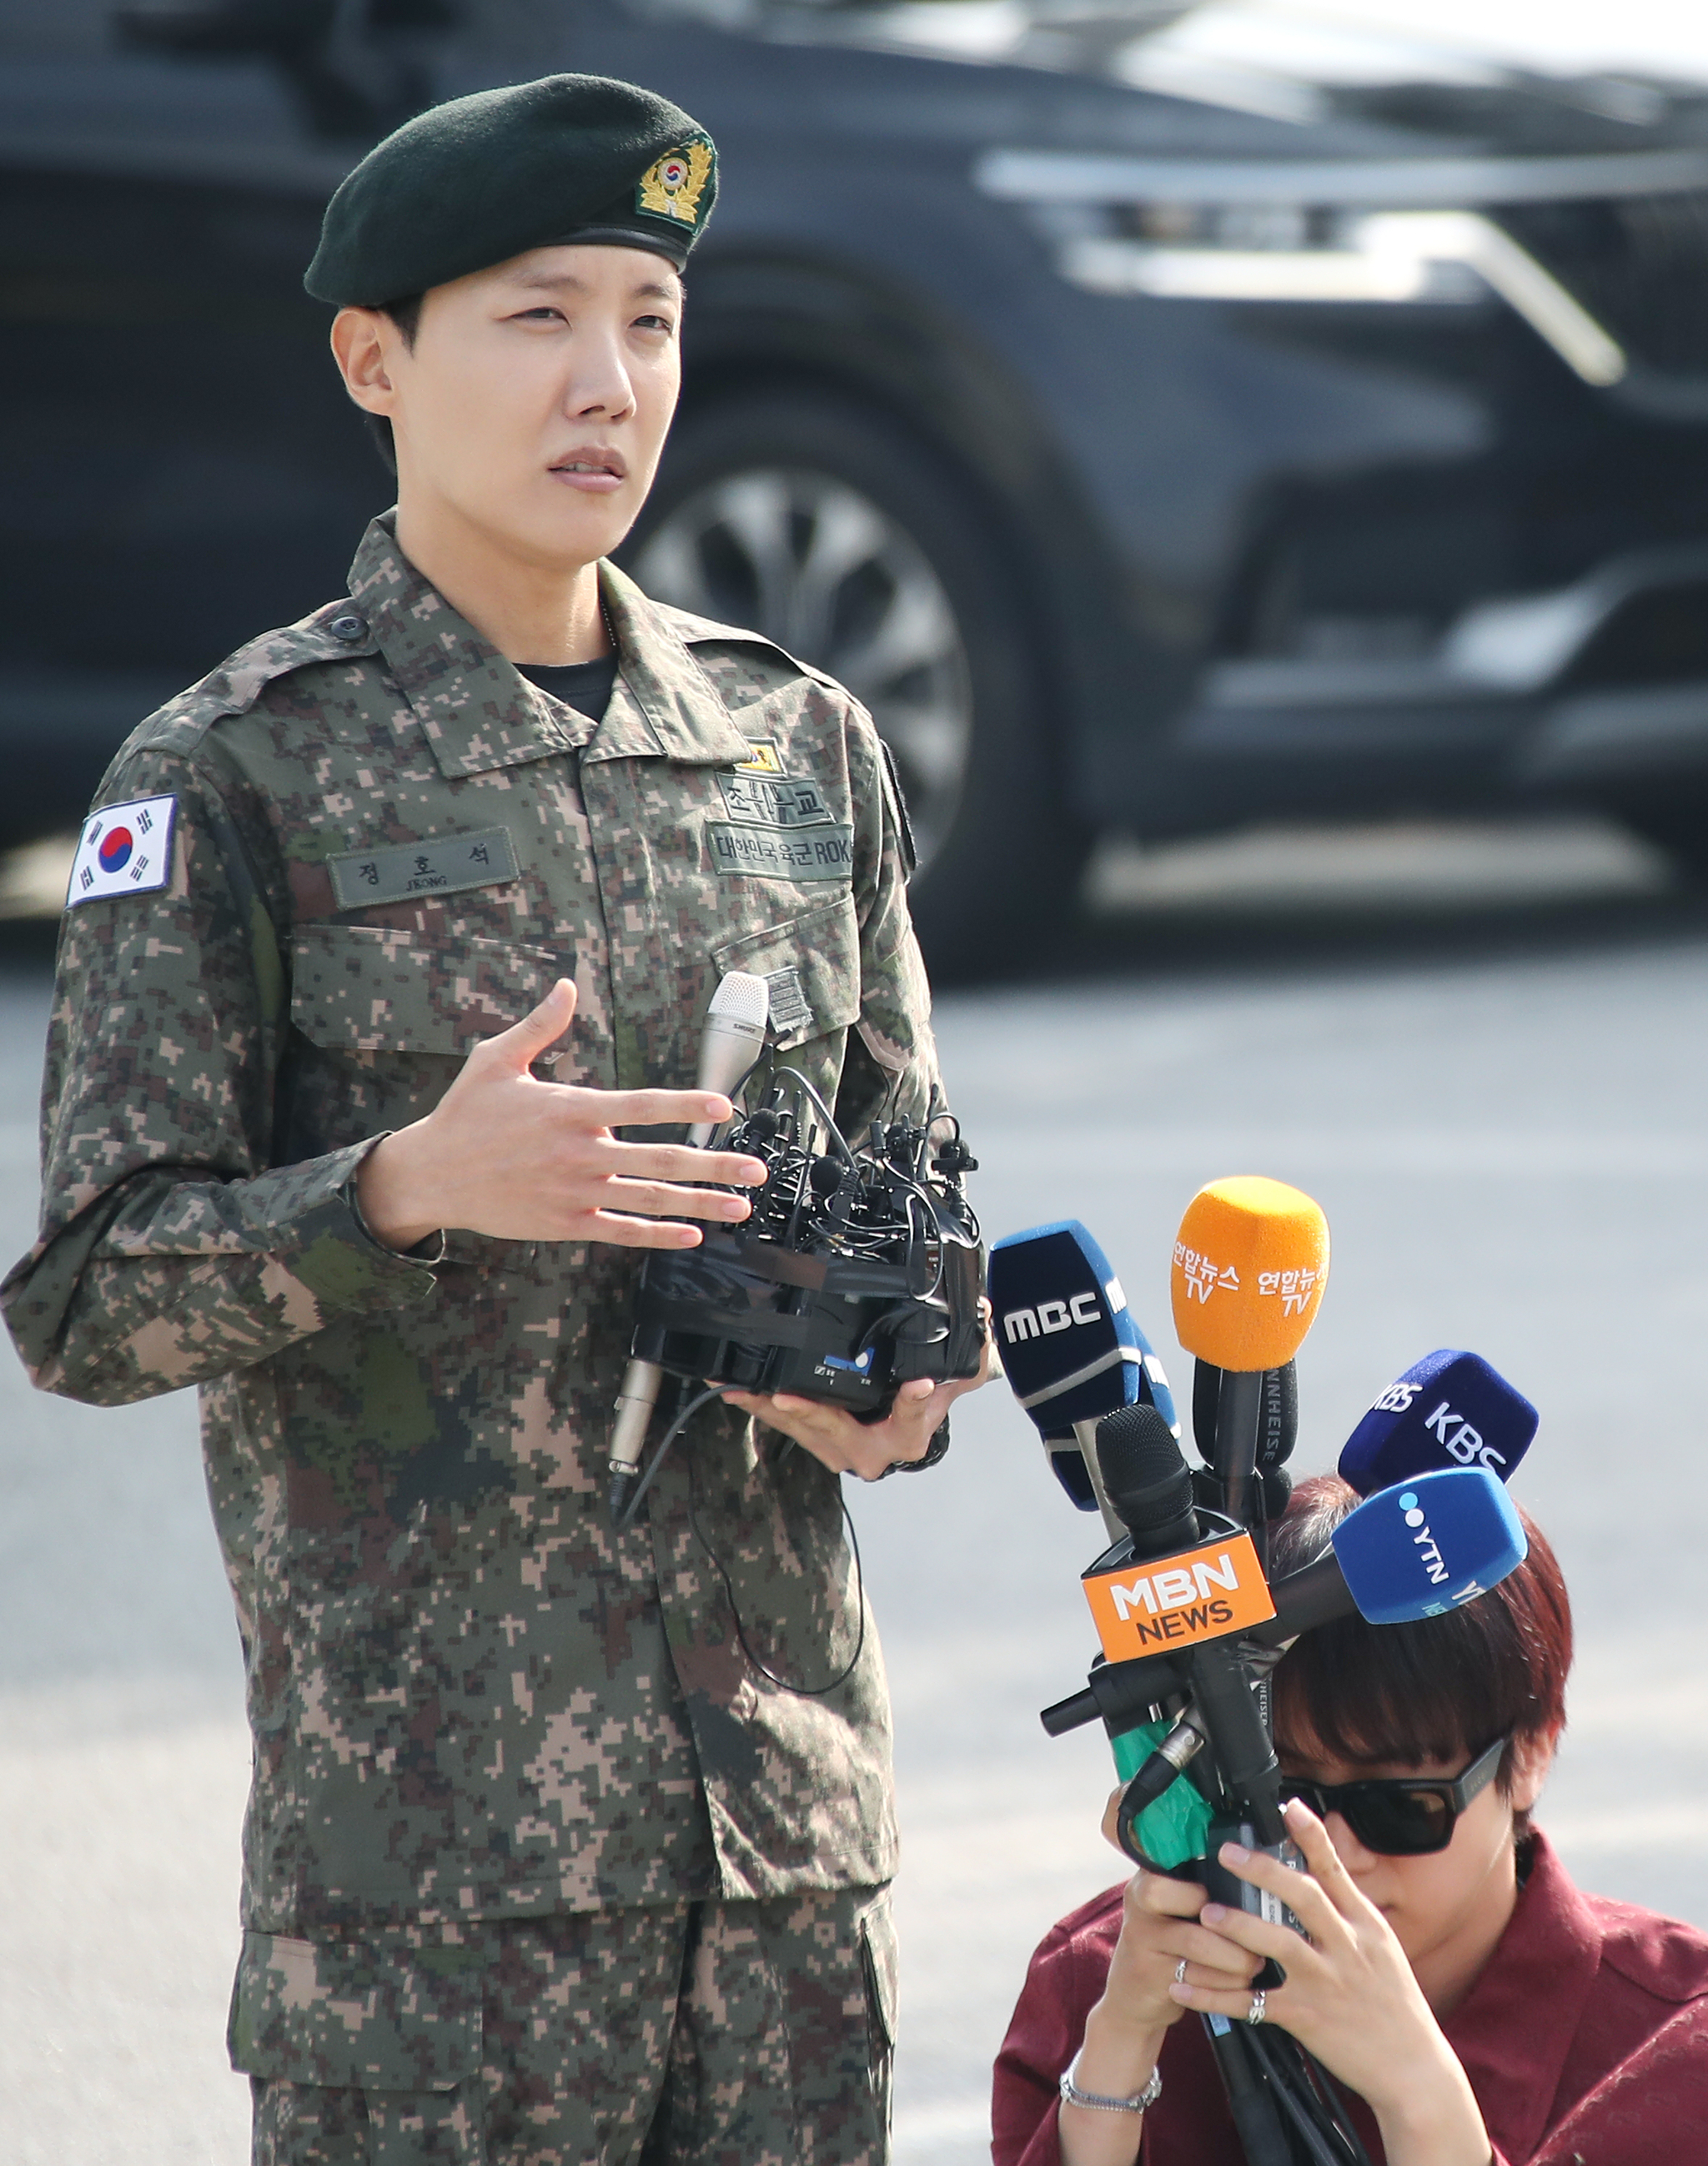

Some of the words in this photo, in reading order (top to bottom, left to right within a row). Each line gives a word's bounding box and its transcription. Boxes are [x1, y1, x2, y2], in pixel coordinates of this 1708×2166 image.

[406, 876, 447, 892] JEONG
[1173, 1241, 1241, 1291] 연합뉴스
[1184, 1273, 1214, 1305] TV
[1282, 1291, 1313, 1318] TV
[1003, 1291, 1102, 1344] MBC
[1369, 1384, 1423, 1413] KBS
[1414, 1526, 1449, 1585] YTN
[1109, 1554, 1239, 1621] MBN
[1136, 1600, 1233, 1645] NEWS
